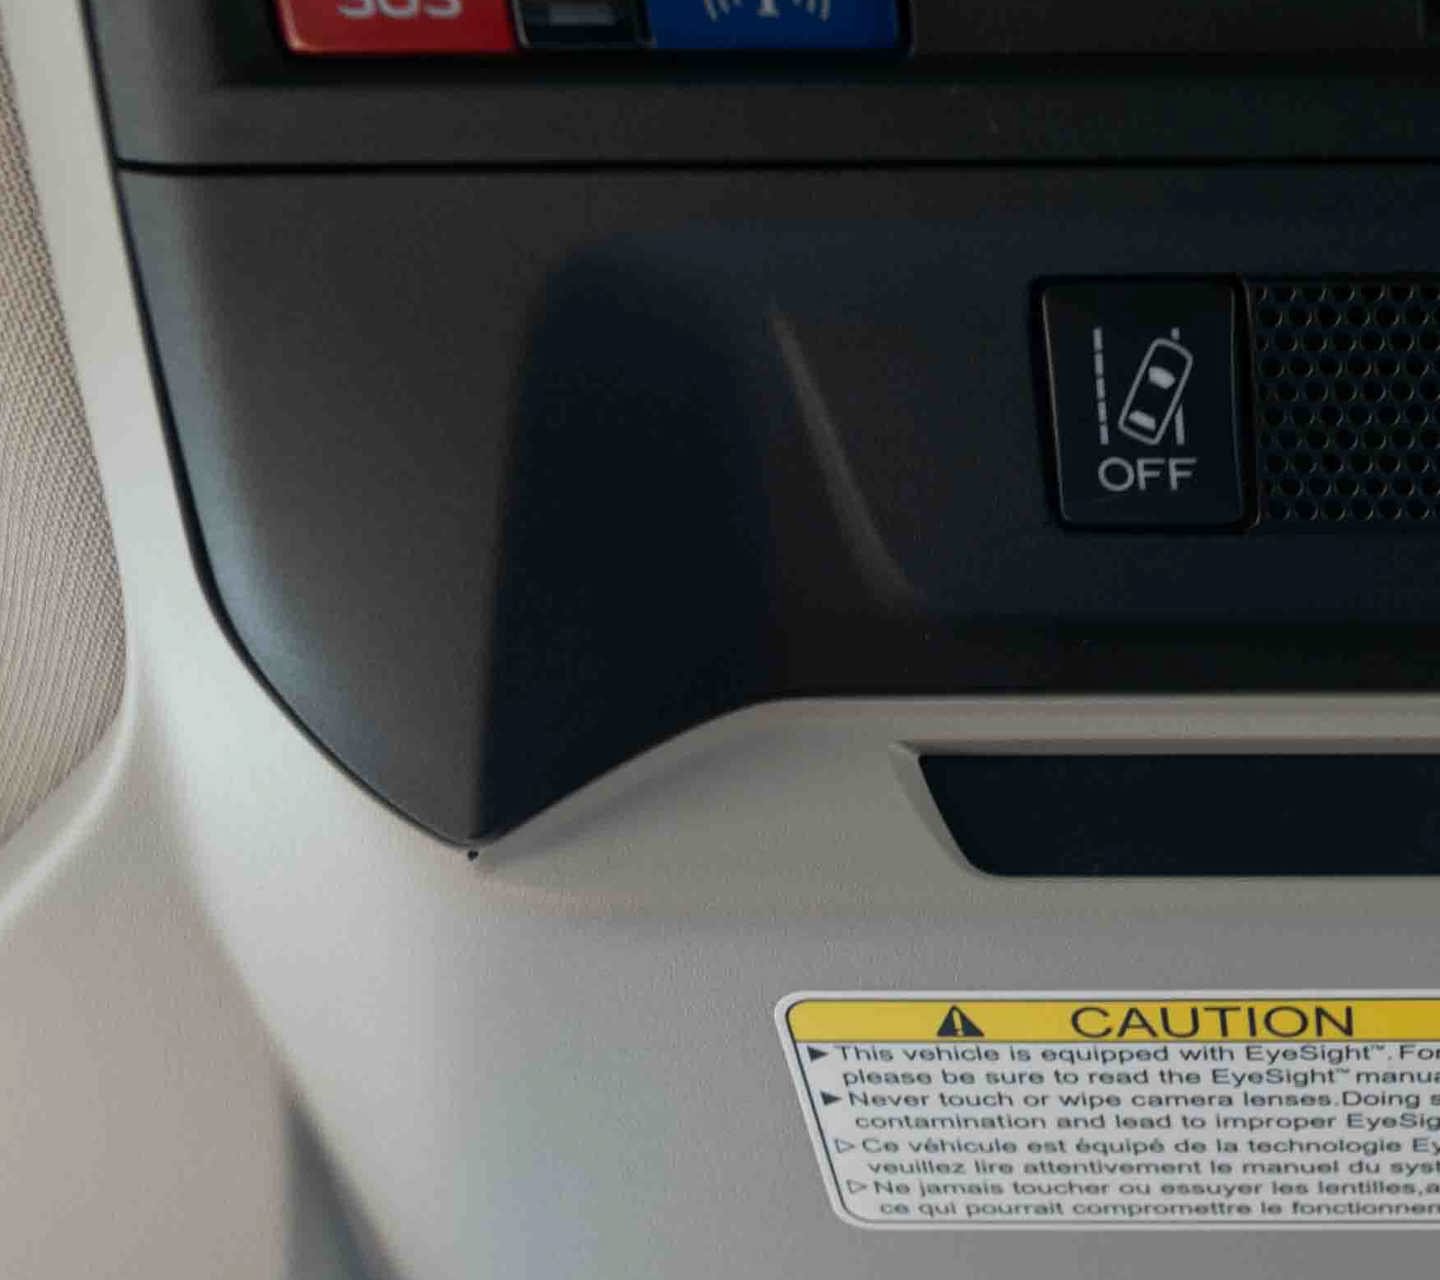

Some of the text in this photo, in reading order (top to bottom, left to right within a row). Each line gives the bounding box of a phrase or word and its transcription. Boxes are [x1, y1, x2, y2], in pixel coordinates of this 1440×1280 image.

[1098, 456, 1197, 493] OFF
[1070, 1006, 1355, 1038] CAUTION
[834, 1045, 893, 1061] This
[901, 1044, 1001, 1062] vehicle
[1009, 1044, 1032, 1061] is
[1040, 1044, 1170, 1065] equipped
[1179, 1044, 1236, 1061] with
[843, 1069, 932, 1087] please
[942, 1069, 975, 1084] be
[985, 1072, 1045, 1084] sure
[1055, 1070, 1079, 1084] to
[1088, 1070, 1149, 1084] read
[1159, 1069, 1201, 1084] the
[848, 1092, 930, 1107] Never
[939, 1092, 1013, 1107] touch
[1023, 1095, 1049, 1107] or
[1059, 1092, 1121, 1110] wipe
[1131, 1094, 1233, 1107] camera
[855, 1114, 1047, 1129] contamination
[1057, 1113, 1105, 1129] and
[1116, 1113, 1172, 1128] lead
[1182, 1113, 1207, 1129] to
[1216, 1113, 1337, 1132] improper
[862, 1138, 899, 1153] Ce
[908, 1137, 1017, 1153] véhicule
[1027, 1138, 1067, 1153] est
[1075, 1138, 1165, 1156] équipé
[1173, 1138, 1207, 1153] de
[1216, 1138, 1238, 1152] la
[1248, 1137, 1402, 1156] technologie
[867, 1160, 965, 1174] veuillez
[975, 1160, 1014, 1174] lire
[1023, 1160, 1201, 1174] attentivement
[1210, 1160, 1233, 1174] le
[1242, 1159, 1339, 1174] manuel
[1348, 1159, 1380, 1173] du
[874, 1181, 911, 1194] Ne
[920, 1180, 1004, 1197] jamais
[1013, 1180, 1109, 1195] toucher
[1118, 1182, 1150, 1195] ou
[1160, 1182, 1263, 1198] essuyer
[1272, 1180, 1308, 1195] les
[880, 1203, 909, 1215] ce
[918, 1202, 956, 1218] qui
[966, 1201, 1063, 1218] pourrait
[1072, 1201, 1252, 1217] compromettre
[1261, 1200, 1282, 1214] le
